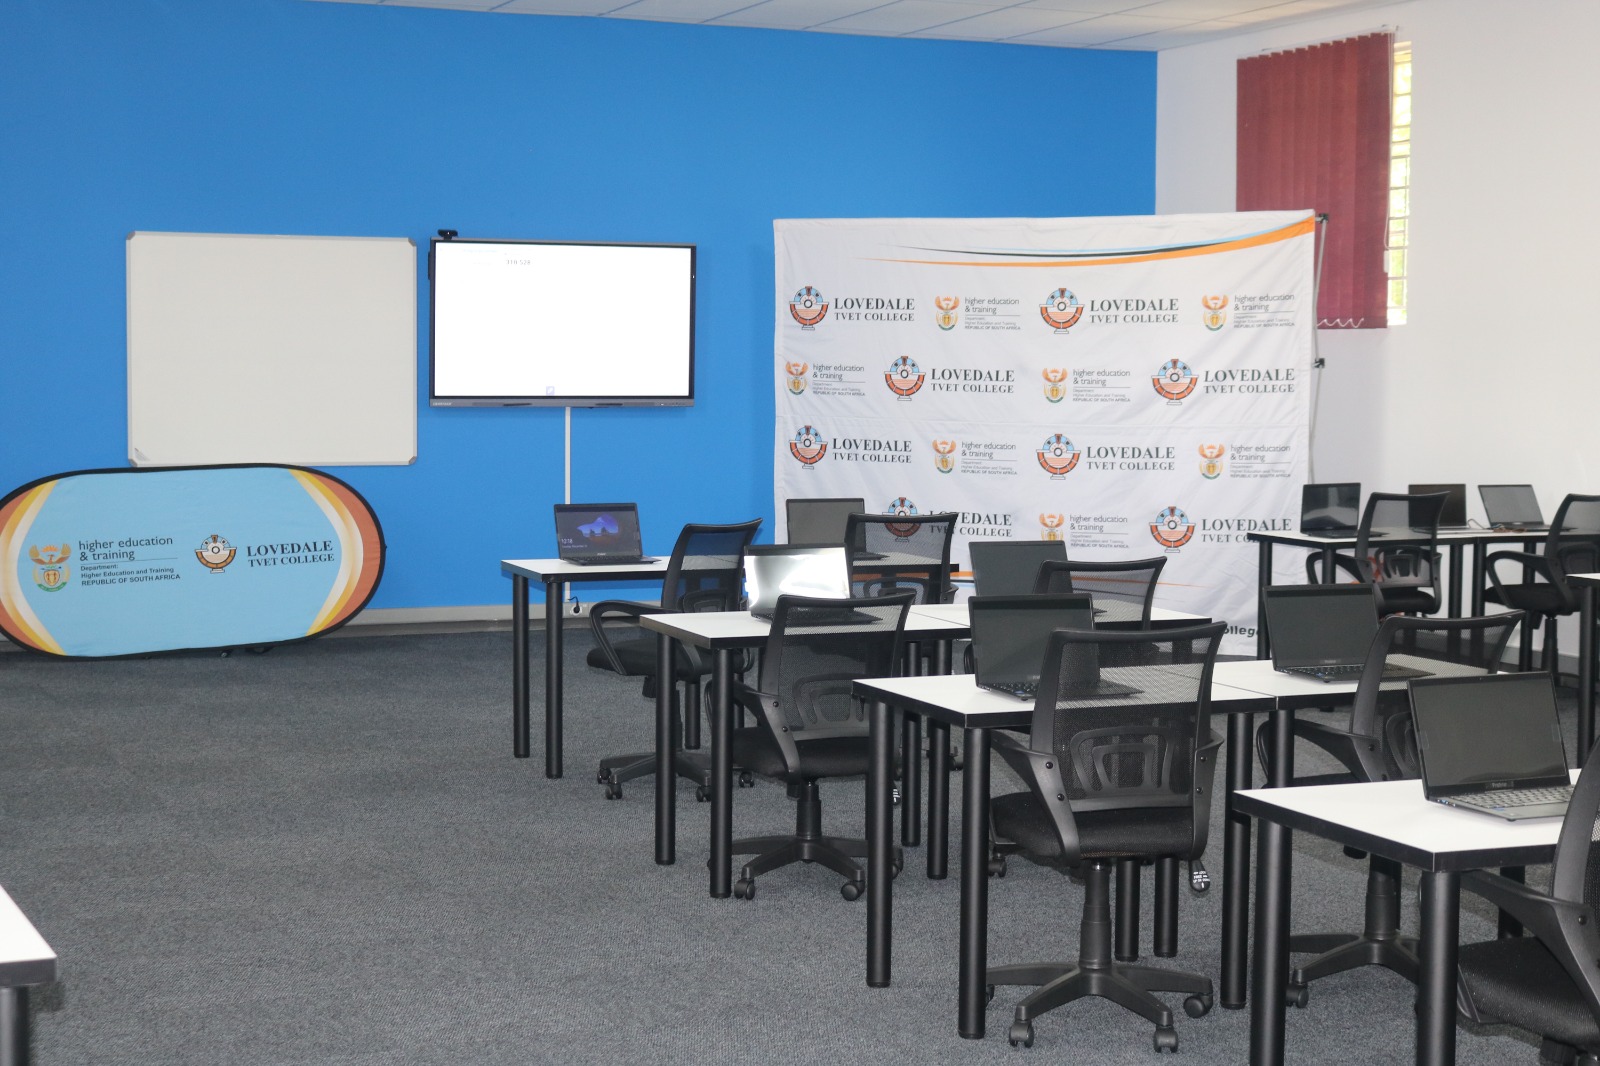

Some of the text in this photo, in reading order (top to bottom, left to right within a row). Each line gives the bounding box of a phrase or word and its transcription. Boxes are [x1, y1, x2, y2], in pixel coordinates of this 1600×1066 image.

[965, 297, 985, 306] higher
[1235, 293, 1294, 304] higher education
[834, 298, 915, 310] LOVEDALE
[1090, 298, 1179, 311] LOVEDALE
[1242, 303, 1269, 312] training
[972, 305, 997, 315] training
[834, 312, 915, 321] TVET COLLEGE
[1090, 314, 1179, 323] TVET COLLEGE
[813, 363, 864, 372] higher education
[813, 371, 843, 382] & training
[931, 368, 1014, 382] LOVEDALE
[1073, 369, 1095, 378] higher
[1204, 368, 1295, 382] LOVEDALE
[1081, 377, 1106, 387] training
[931, 383, 1014, 393] TVET COLLEGE
[1204, 384, 1295, 394] TVET COLLEGE
[833, 438, 912, 452] LOVEDALE
[962, 441, 1016, 450] higher education
[1231, 444, 1290, 454] higher education
[833, 452, 912, 463] TVET COLLEGE
[969, 450, 993, 460] training
[1087, 446, 1175, 459] LOVEDALE
[1231, 453, 1265, 463] & training
[1087, 461, 1175, 470] TVET COLLEGE
[1070, 514, 1127, 524] higher education
[1078, 523, 1104, 533] training
[1202, 518, 1292, 531] LOVEDALE
[960, 527, 1012, 537] COLLEGE
[1201, 534, 1231, 543] TVET
[79, 536, 173, 552] higher education
[247, 540, 333, 557] LOVEDALE
[80, 550, 135, 561] & training
[248, 553, 335, 567] TVET COLLEGE
[149, 567, 174, 575] Training
[130, 575, 153, 583] SOUTH
